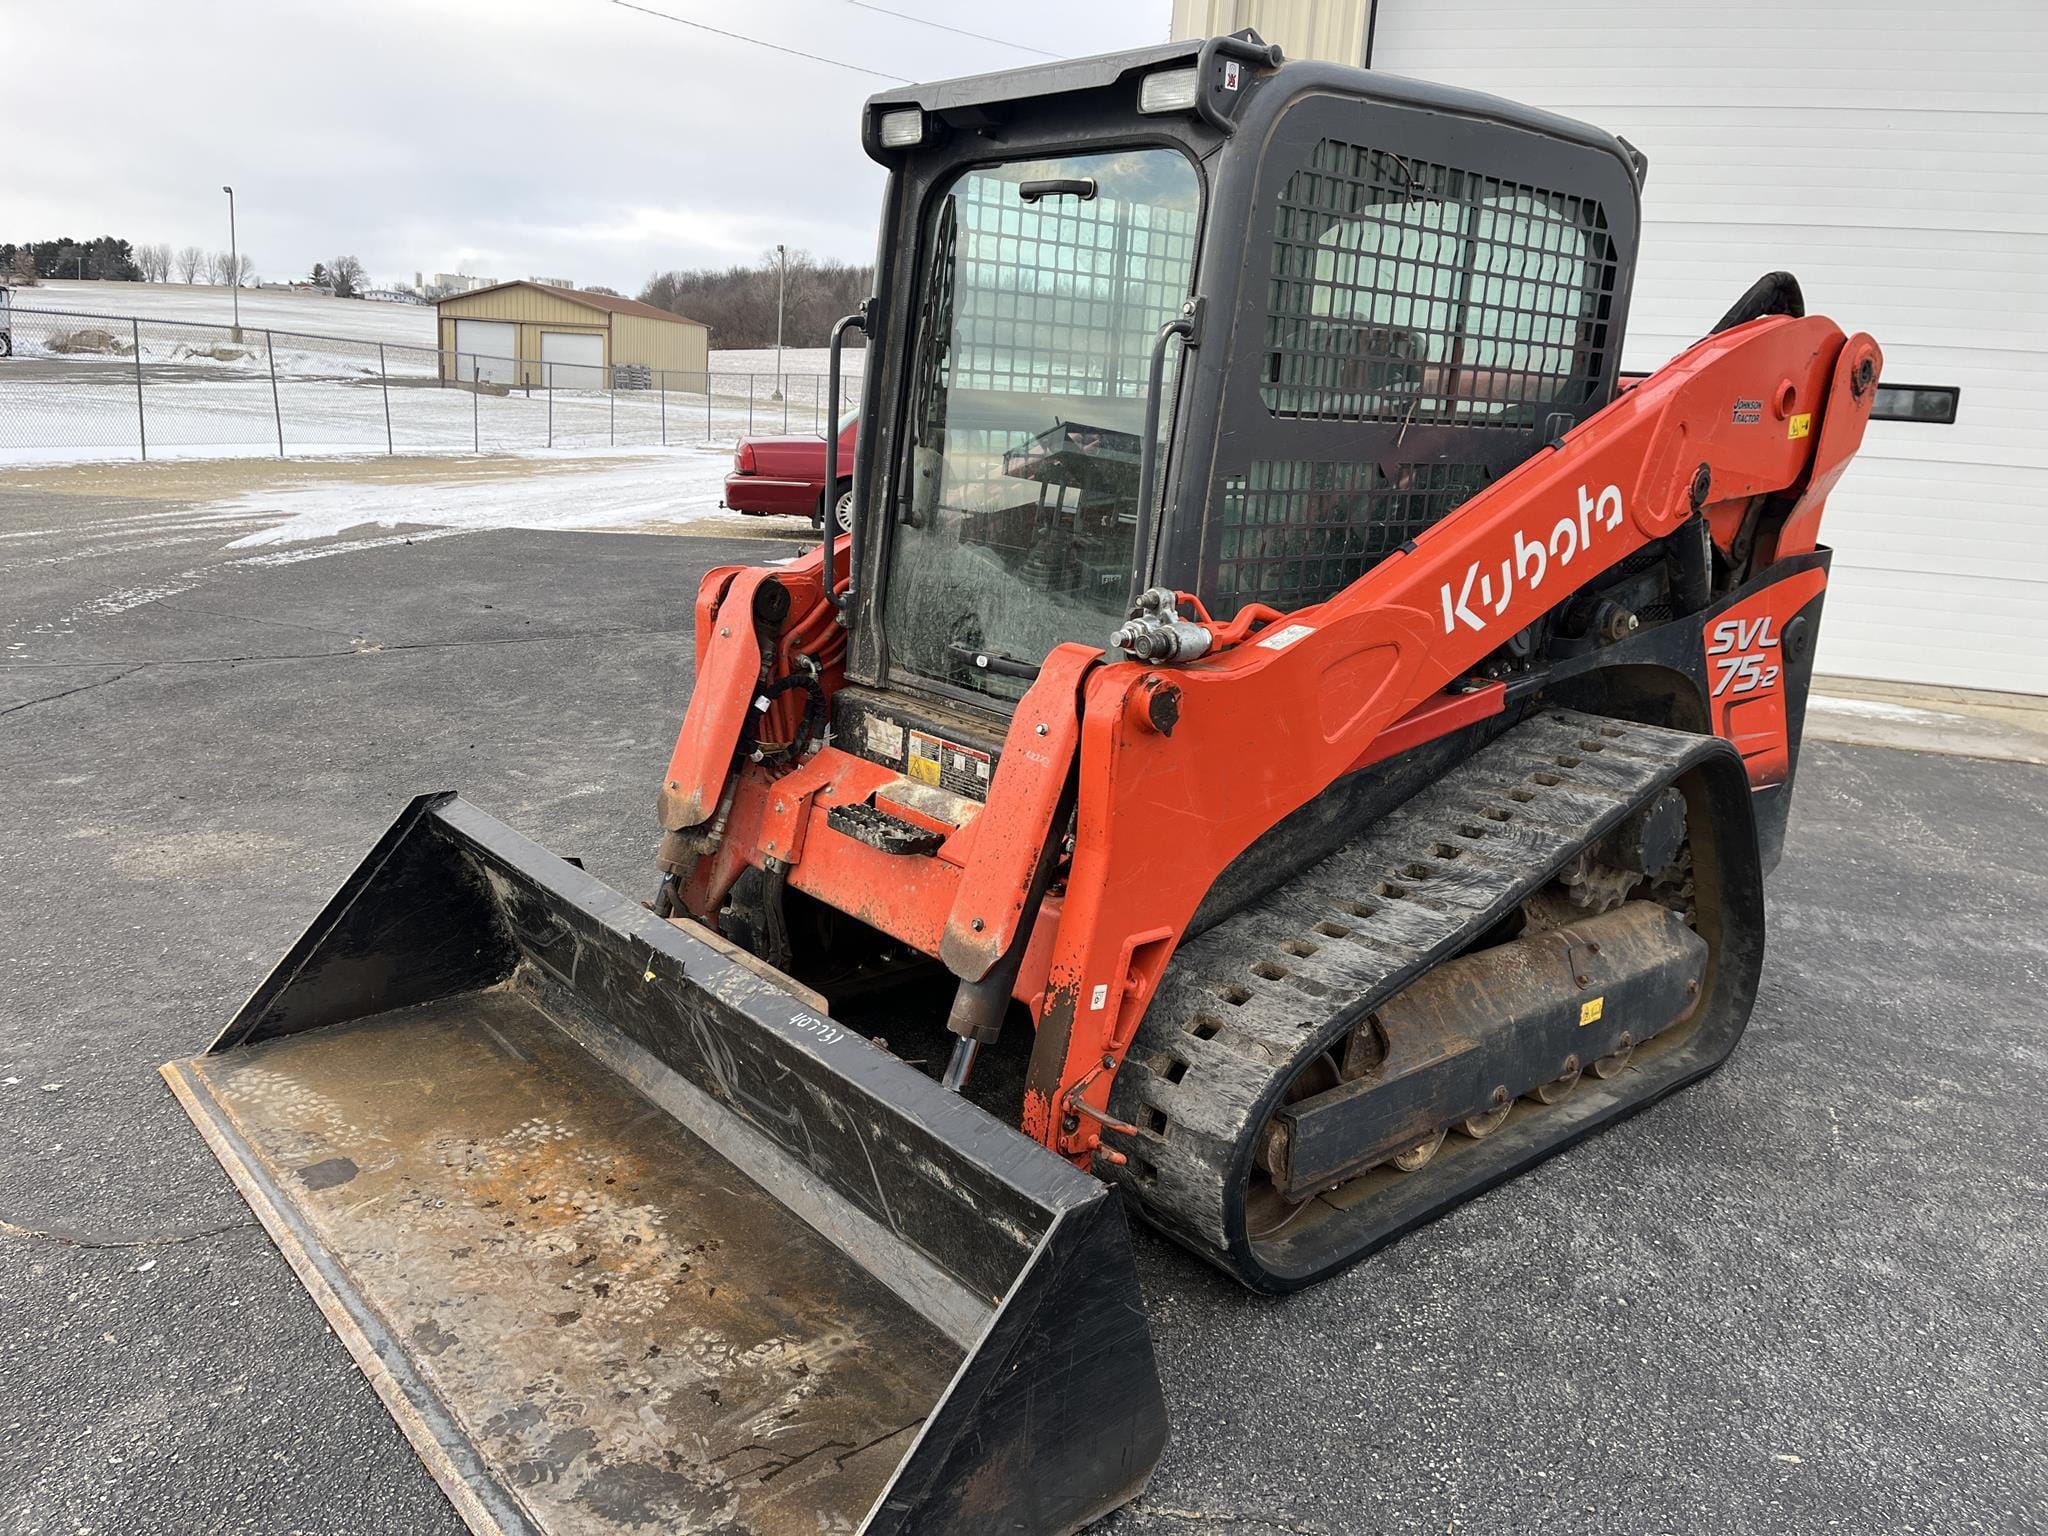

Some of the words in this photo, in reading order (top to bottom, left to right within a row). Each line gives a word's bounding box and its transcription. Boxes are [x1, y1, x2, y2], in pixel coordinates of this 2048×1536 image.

[1733, 397, 1762, 410] JOHNSON
[1732, 411, 1760, 423] TRACTOR
[1441, 484, 1623, 634] Kubota
[1708, 616, 1779, 655] SVL
